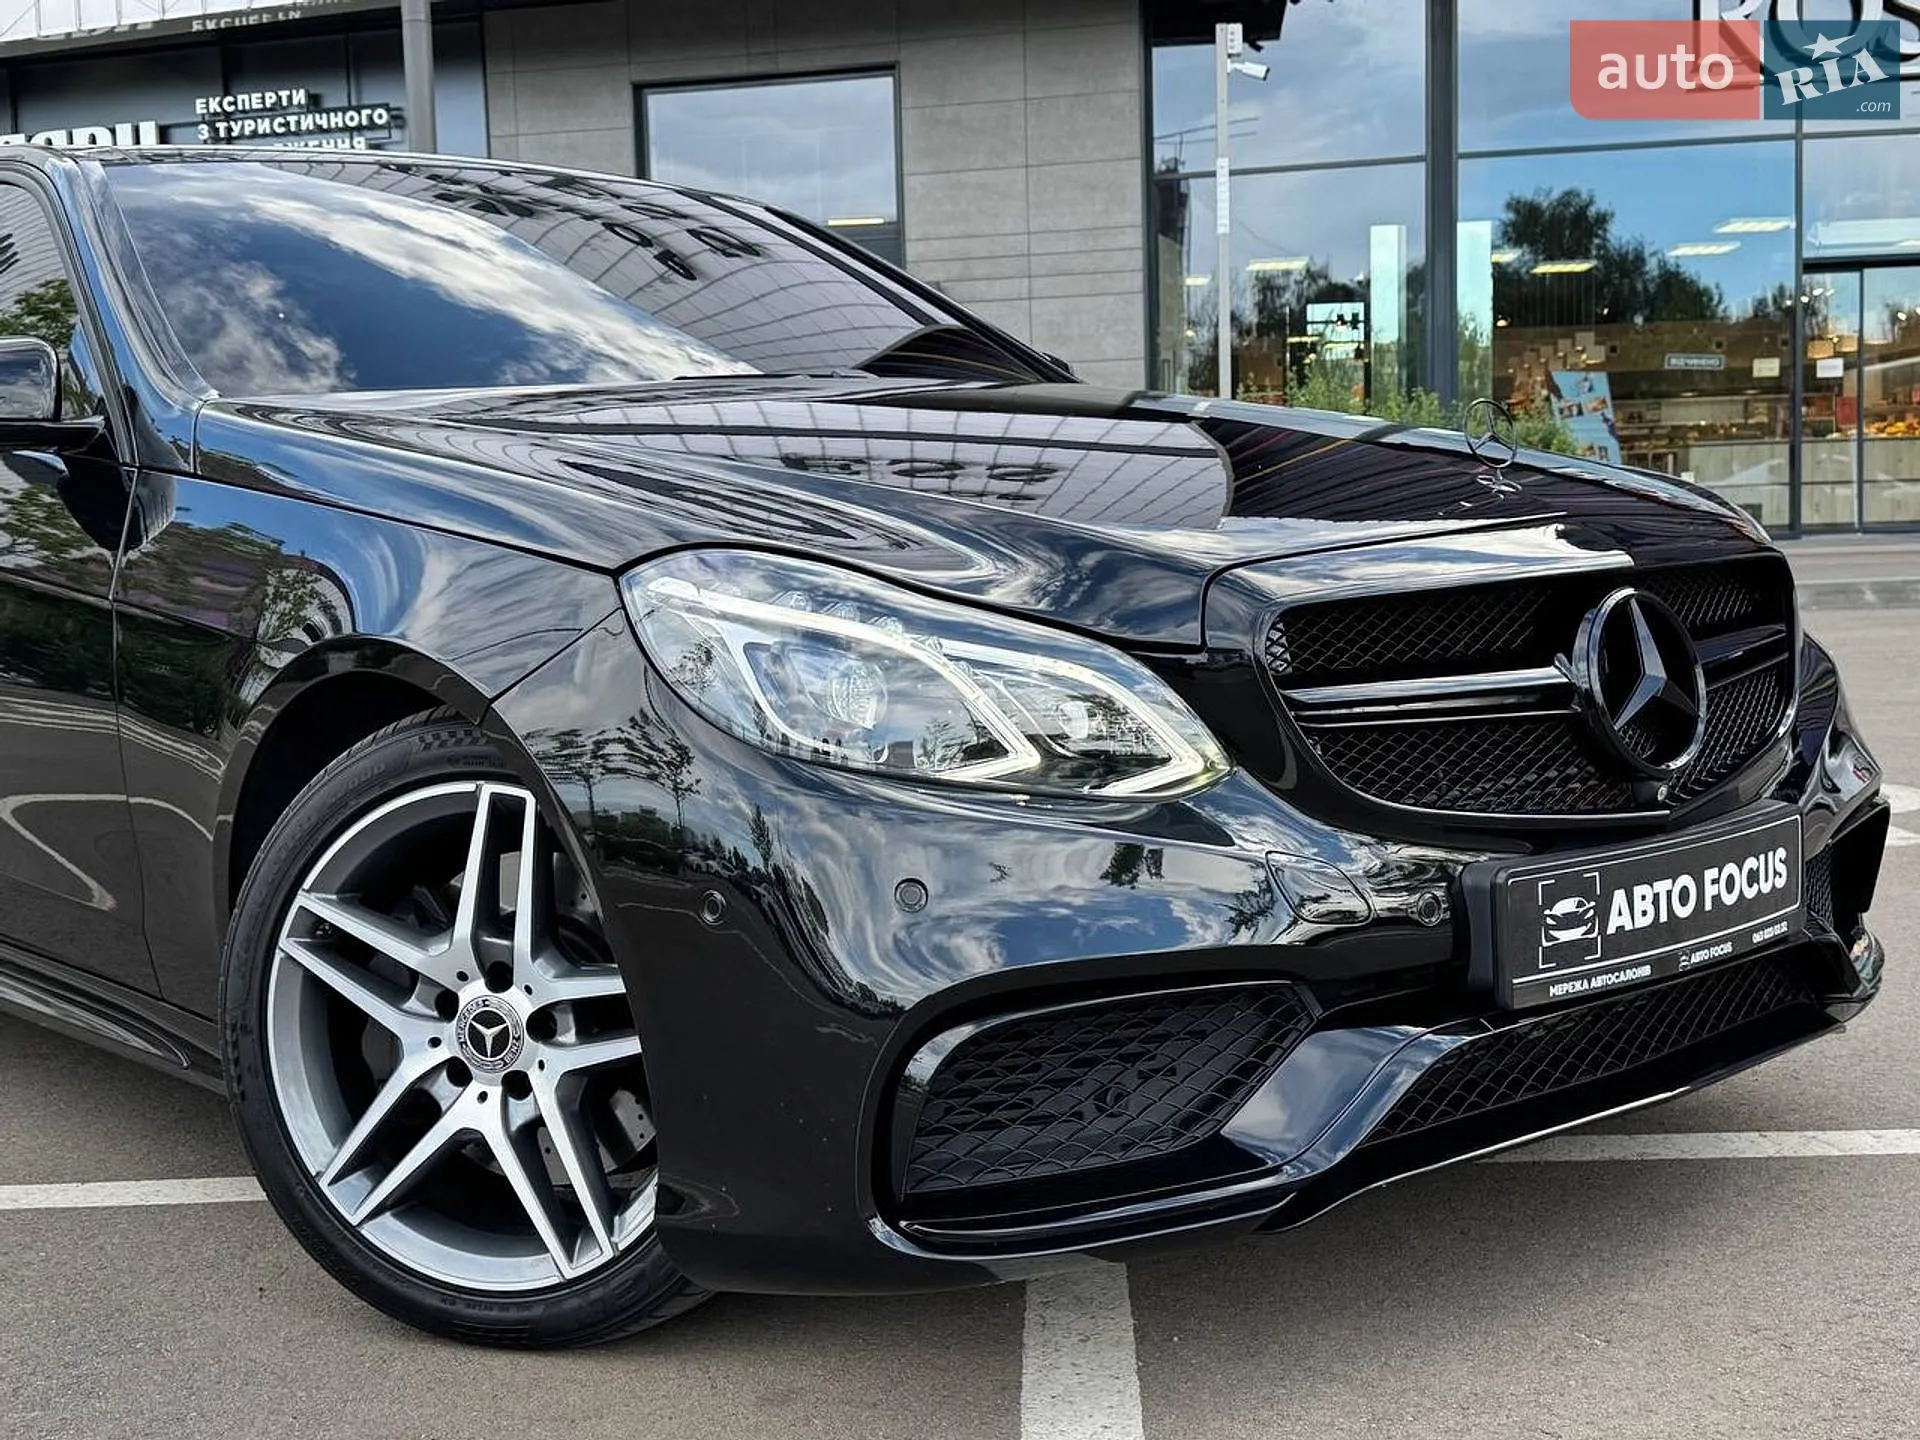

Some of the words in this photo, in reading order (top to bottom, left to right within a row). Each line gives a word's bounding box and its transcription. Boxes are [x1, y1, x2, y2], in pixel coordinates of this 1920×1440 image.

[195, 88, 306, 115] ЕКСПЕРТИ
[215, 108, 388, 139] ТУРИСТИЧНОГО
[1606, 874, 1697, 935] АВТО
[1703, 847, 1788, 912] FOCUS
[1549, 978, 1590, 997] МЕРЕЖА
[1590, 964, 1652, 989] АВТОСАЛОНІВ
